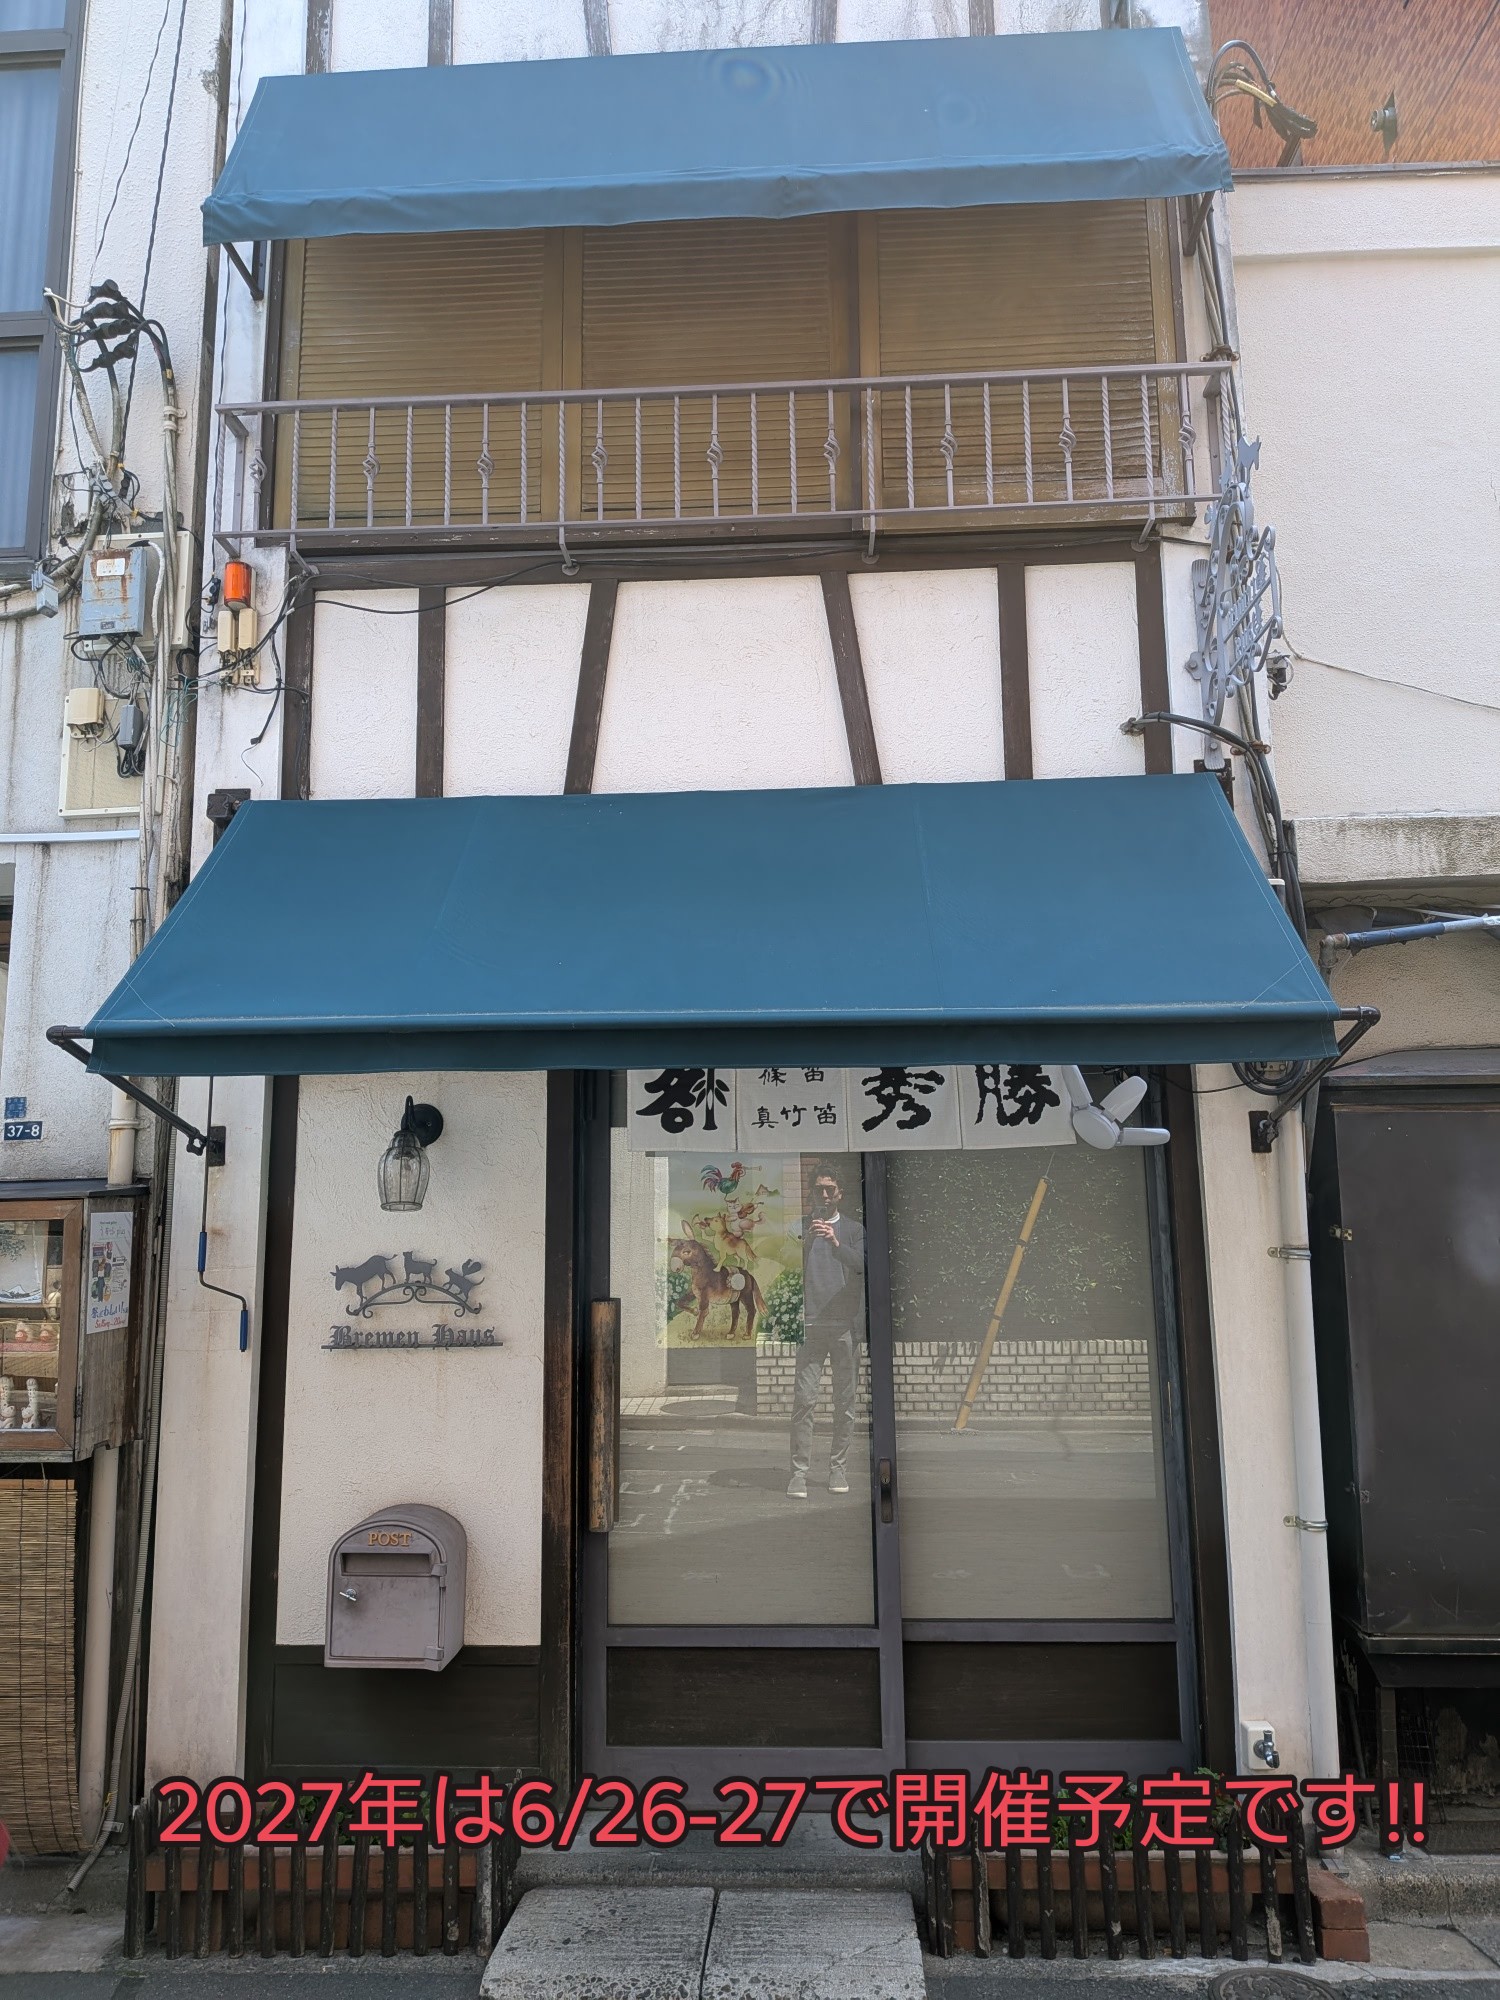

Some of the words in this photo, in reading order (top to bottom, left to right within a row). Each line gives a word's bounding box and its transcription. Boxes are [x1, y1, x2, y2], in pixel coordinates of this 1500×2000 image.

[751, 1102, 836, 1128] 真竹笛
[7, 1124, 40, 1138] 37-8
[329, 1325, 420, 1348] Bremen
[432, 1324, 496, 1346] Haus
[368, 1532, 413, 1547] POST
